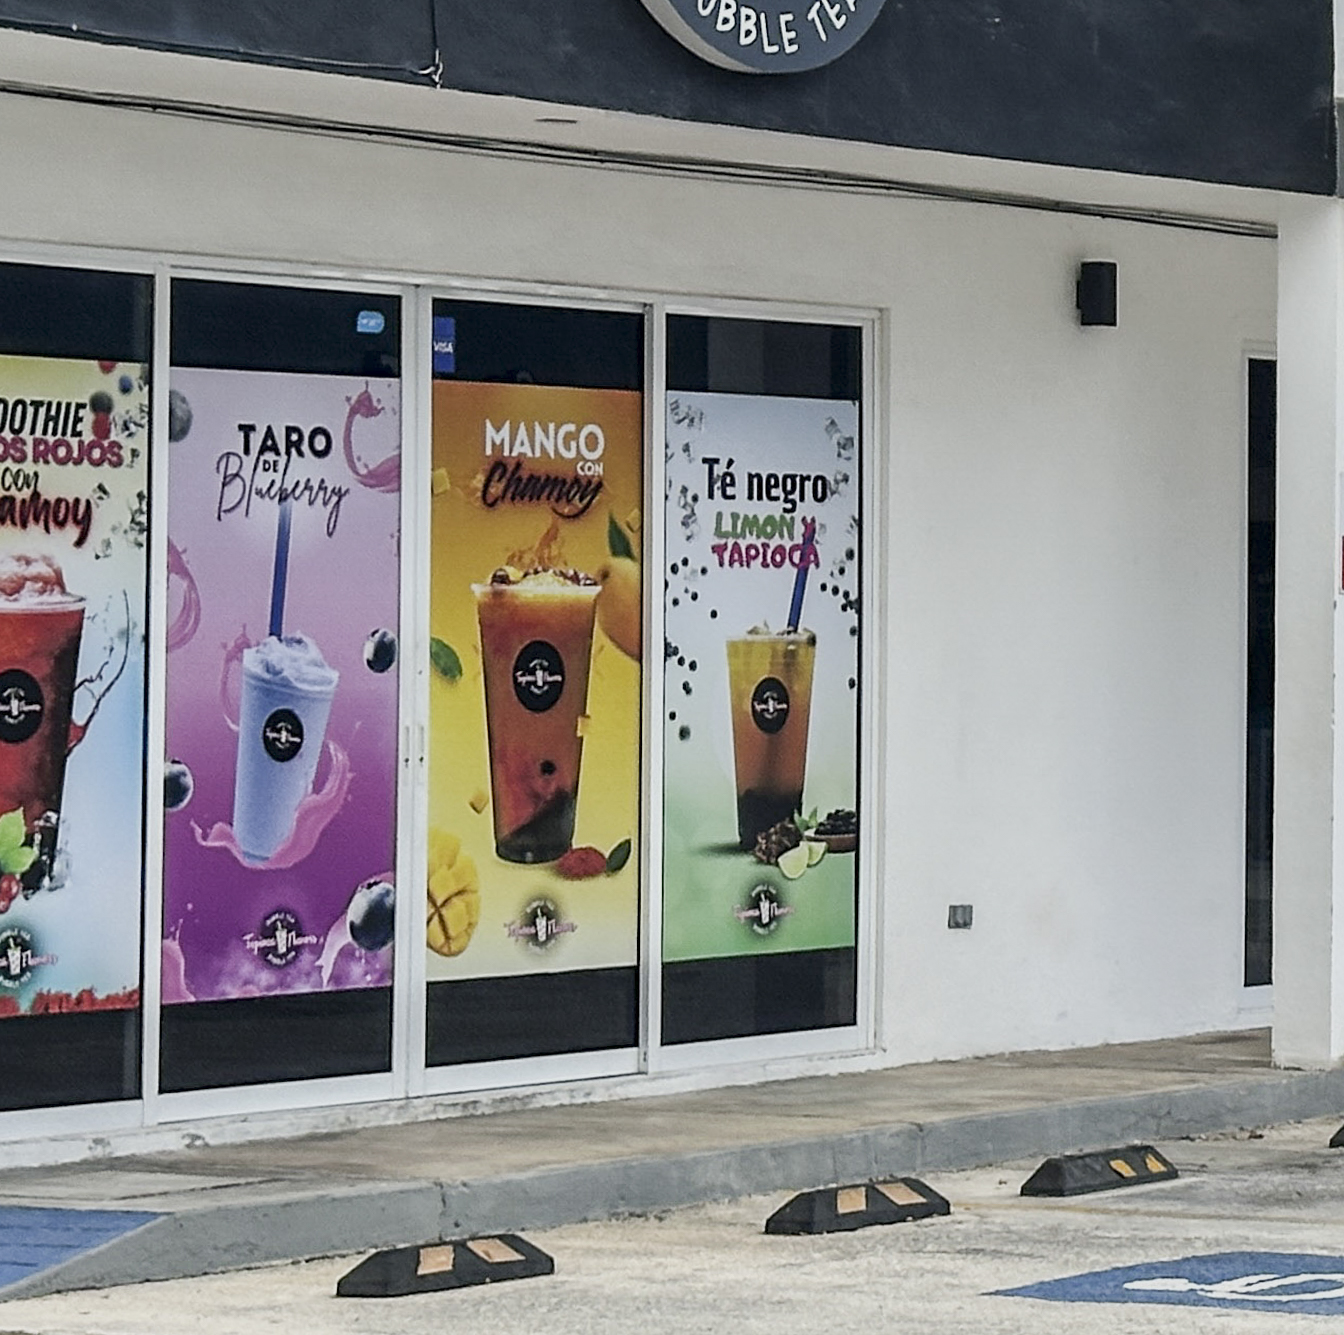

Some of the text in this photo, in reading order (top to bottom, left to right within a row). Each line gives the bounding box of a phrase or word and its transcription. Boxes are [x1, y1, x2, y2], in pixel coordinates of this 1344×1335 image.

[433, 340, 454, 354] VISA
[32, 436, 124, 468] ROJOS
[238, 423, 332, 458] TARO
[485, 419, 605, 460] MANGO
[1, 466, 39, 492] con
[263, 458, 279, 473] DE
[577, 462, 604, 476] CON
[216, 450, 350, 538] Blueberry
[482, 459, 604, 520] Chamoy
[702, 456, 828, 514] Té negro
[714, 511, 795, 541] LIMON
[711, 540, 820, 569] TAPIOCA
